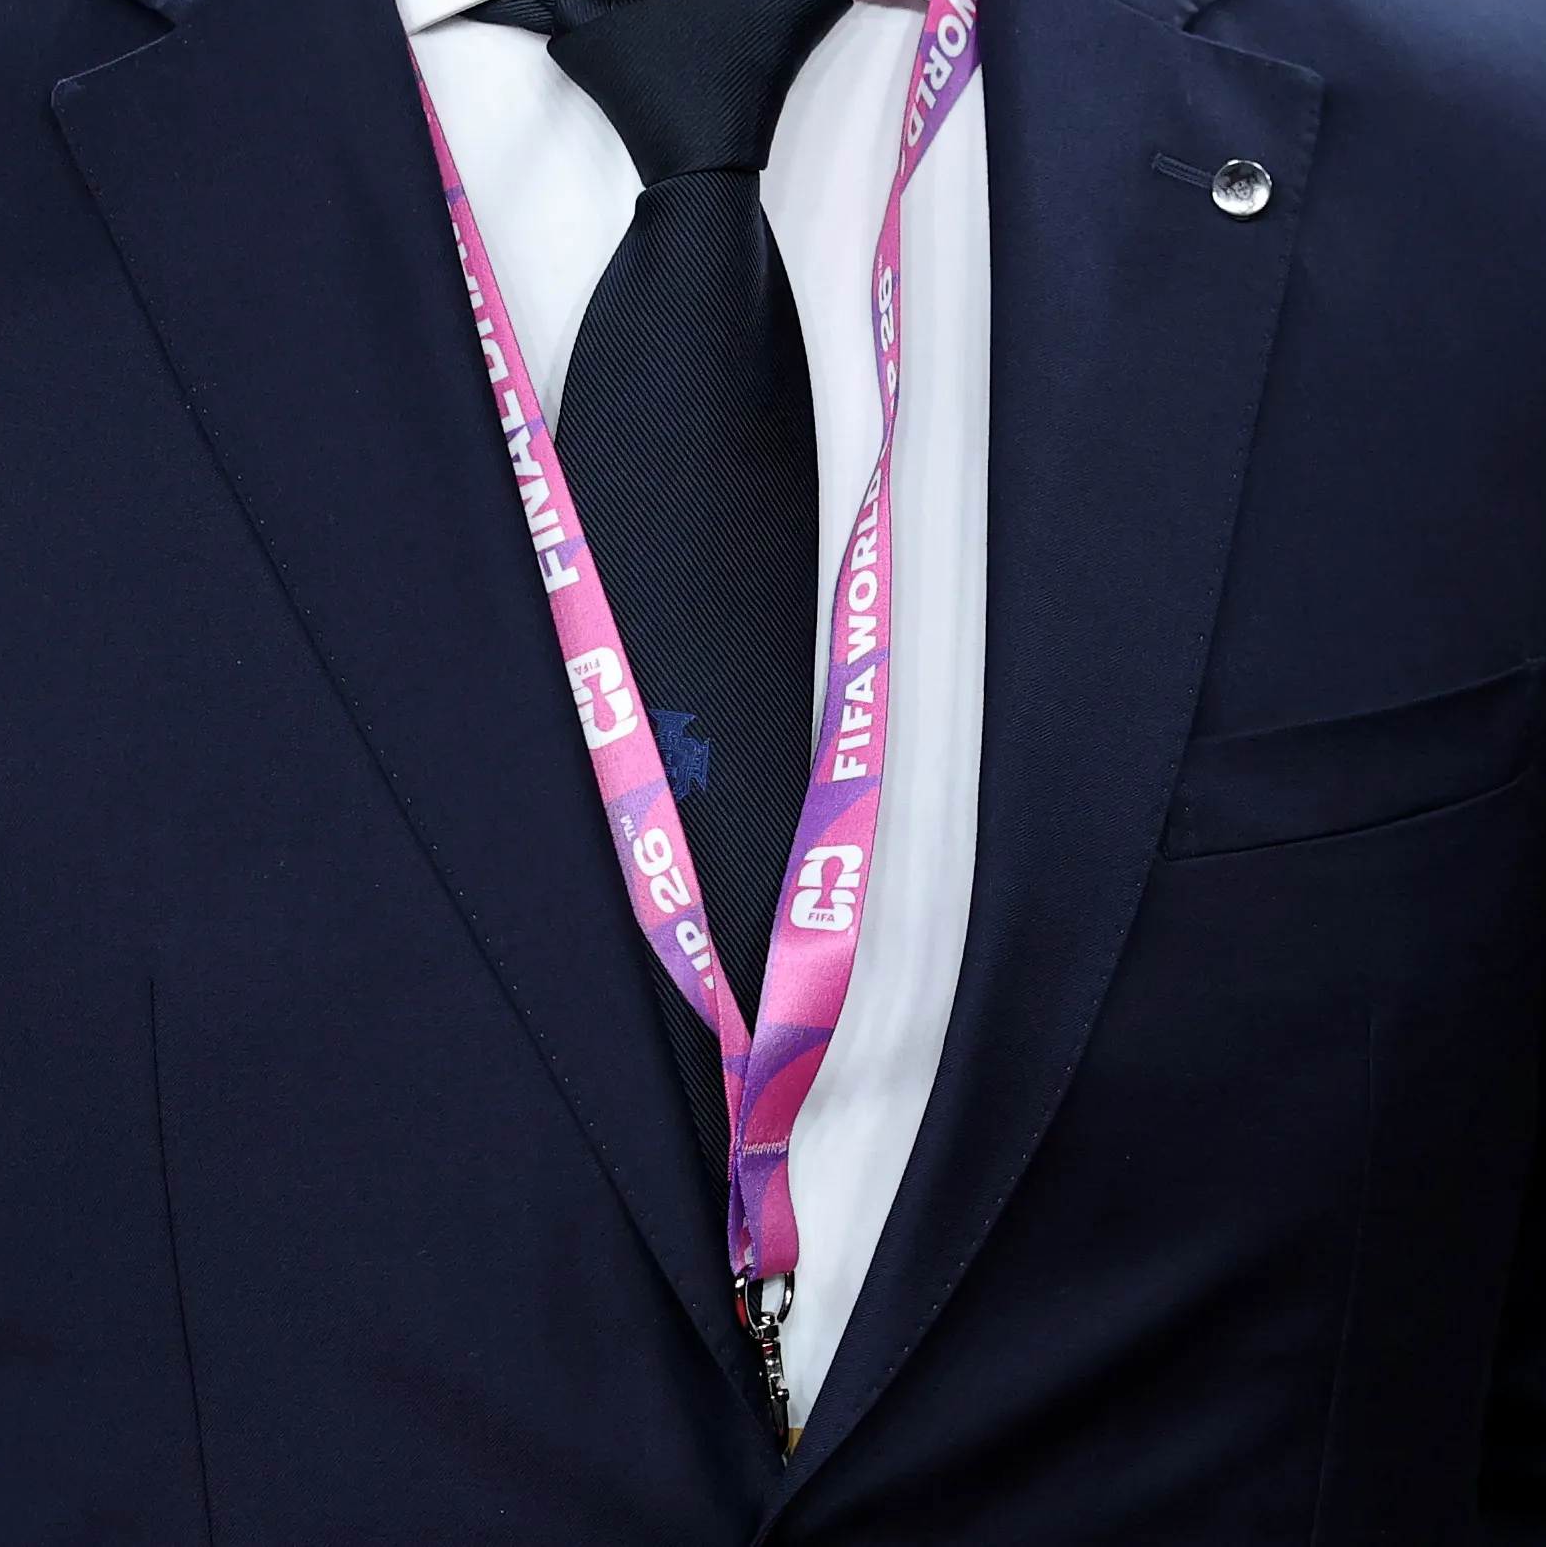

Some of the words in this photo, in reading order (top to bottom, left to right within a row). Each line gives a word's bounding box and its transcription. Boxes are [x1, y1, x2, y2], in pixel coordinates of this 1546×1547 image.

[501, 388, 580, 593] FINAL
[848, 458, 881, 665] WORLD
[832, 665, 876, 782] FIFA
[808, 912, 835, 923] FIFA
